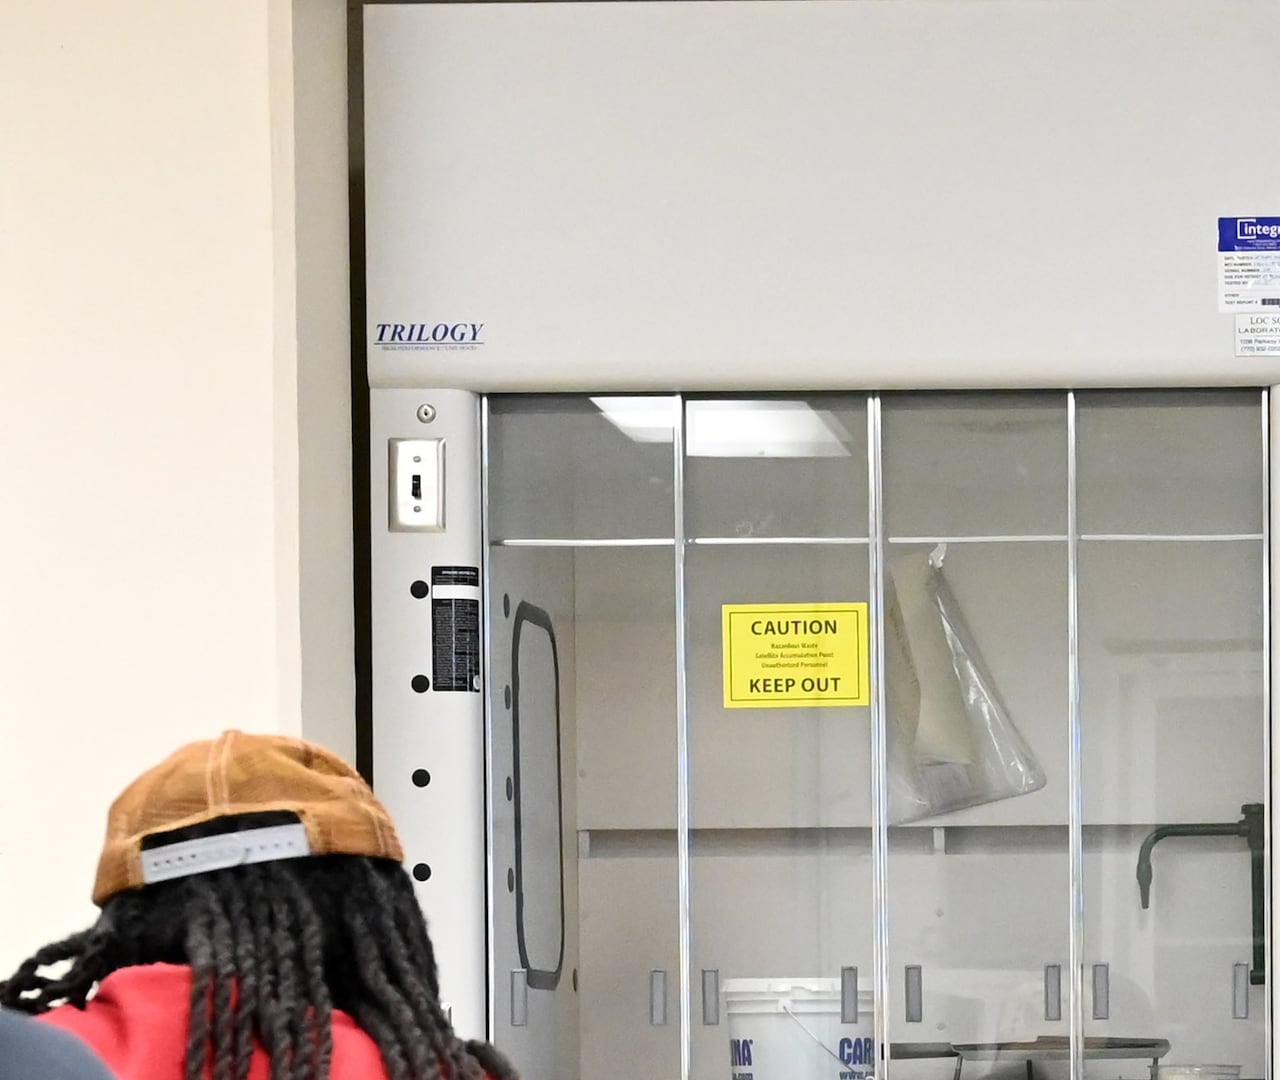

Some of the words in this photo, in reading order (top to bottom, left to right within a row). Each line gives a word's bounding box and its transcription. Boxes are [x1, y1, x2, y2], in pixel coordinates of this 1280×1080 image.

[1250, 316, 1269, 325] LOC
[375, 323, 485, 342] TRILOGY
[751, 619, 837, 635] CAUTION
[749, 678, 796, 693] KEEP
[801, 677, 841, 692] OUT
